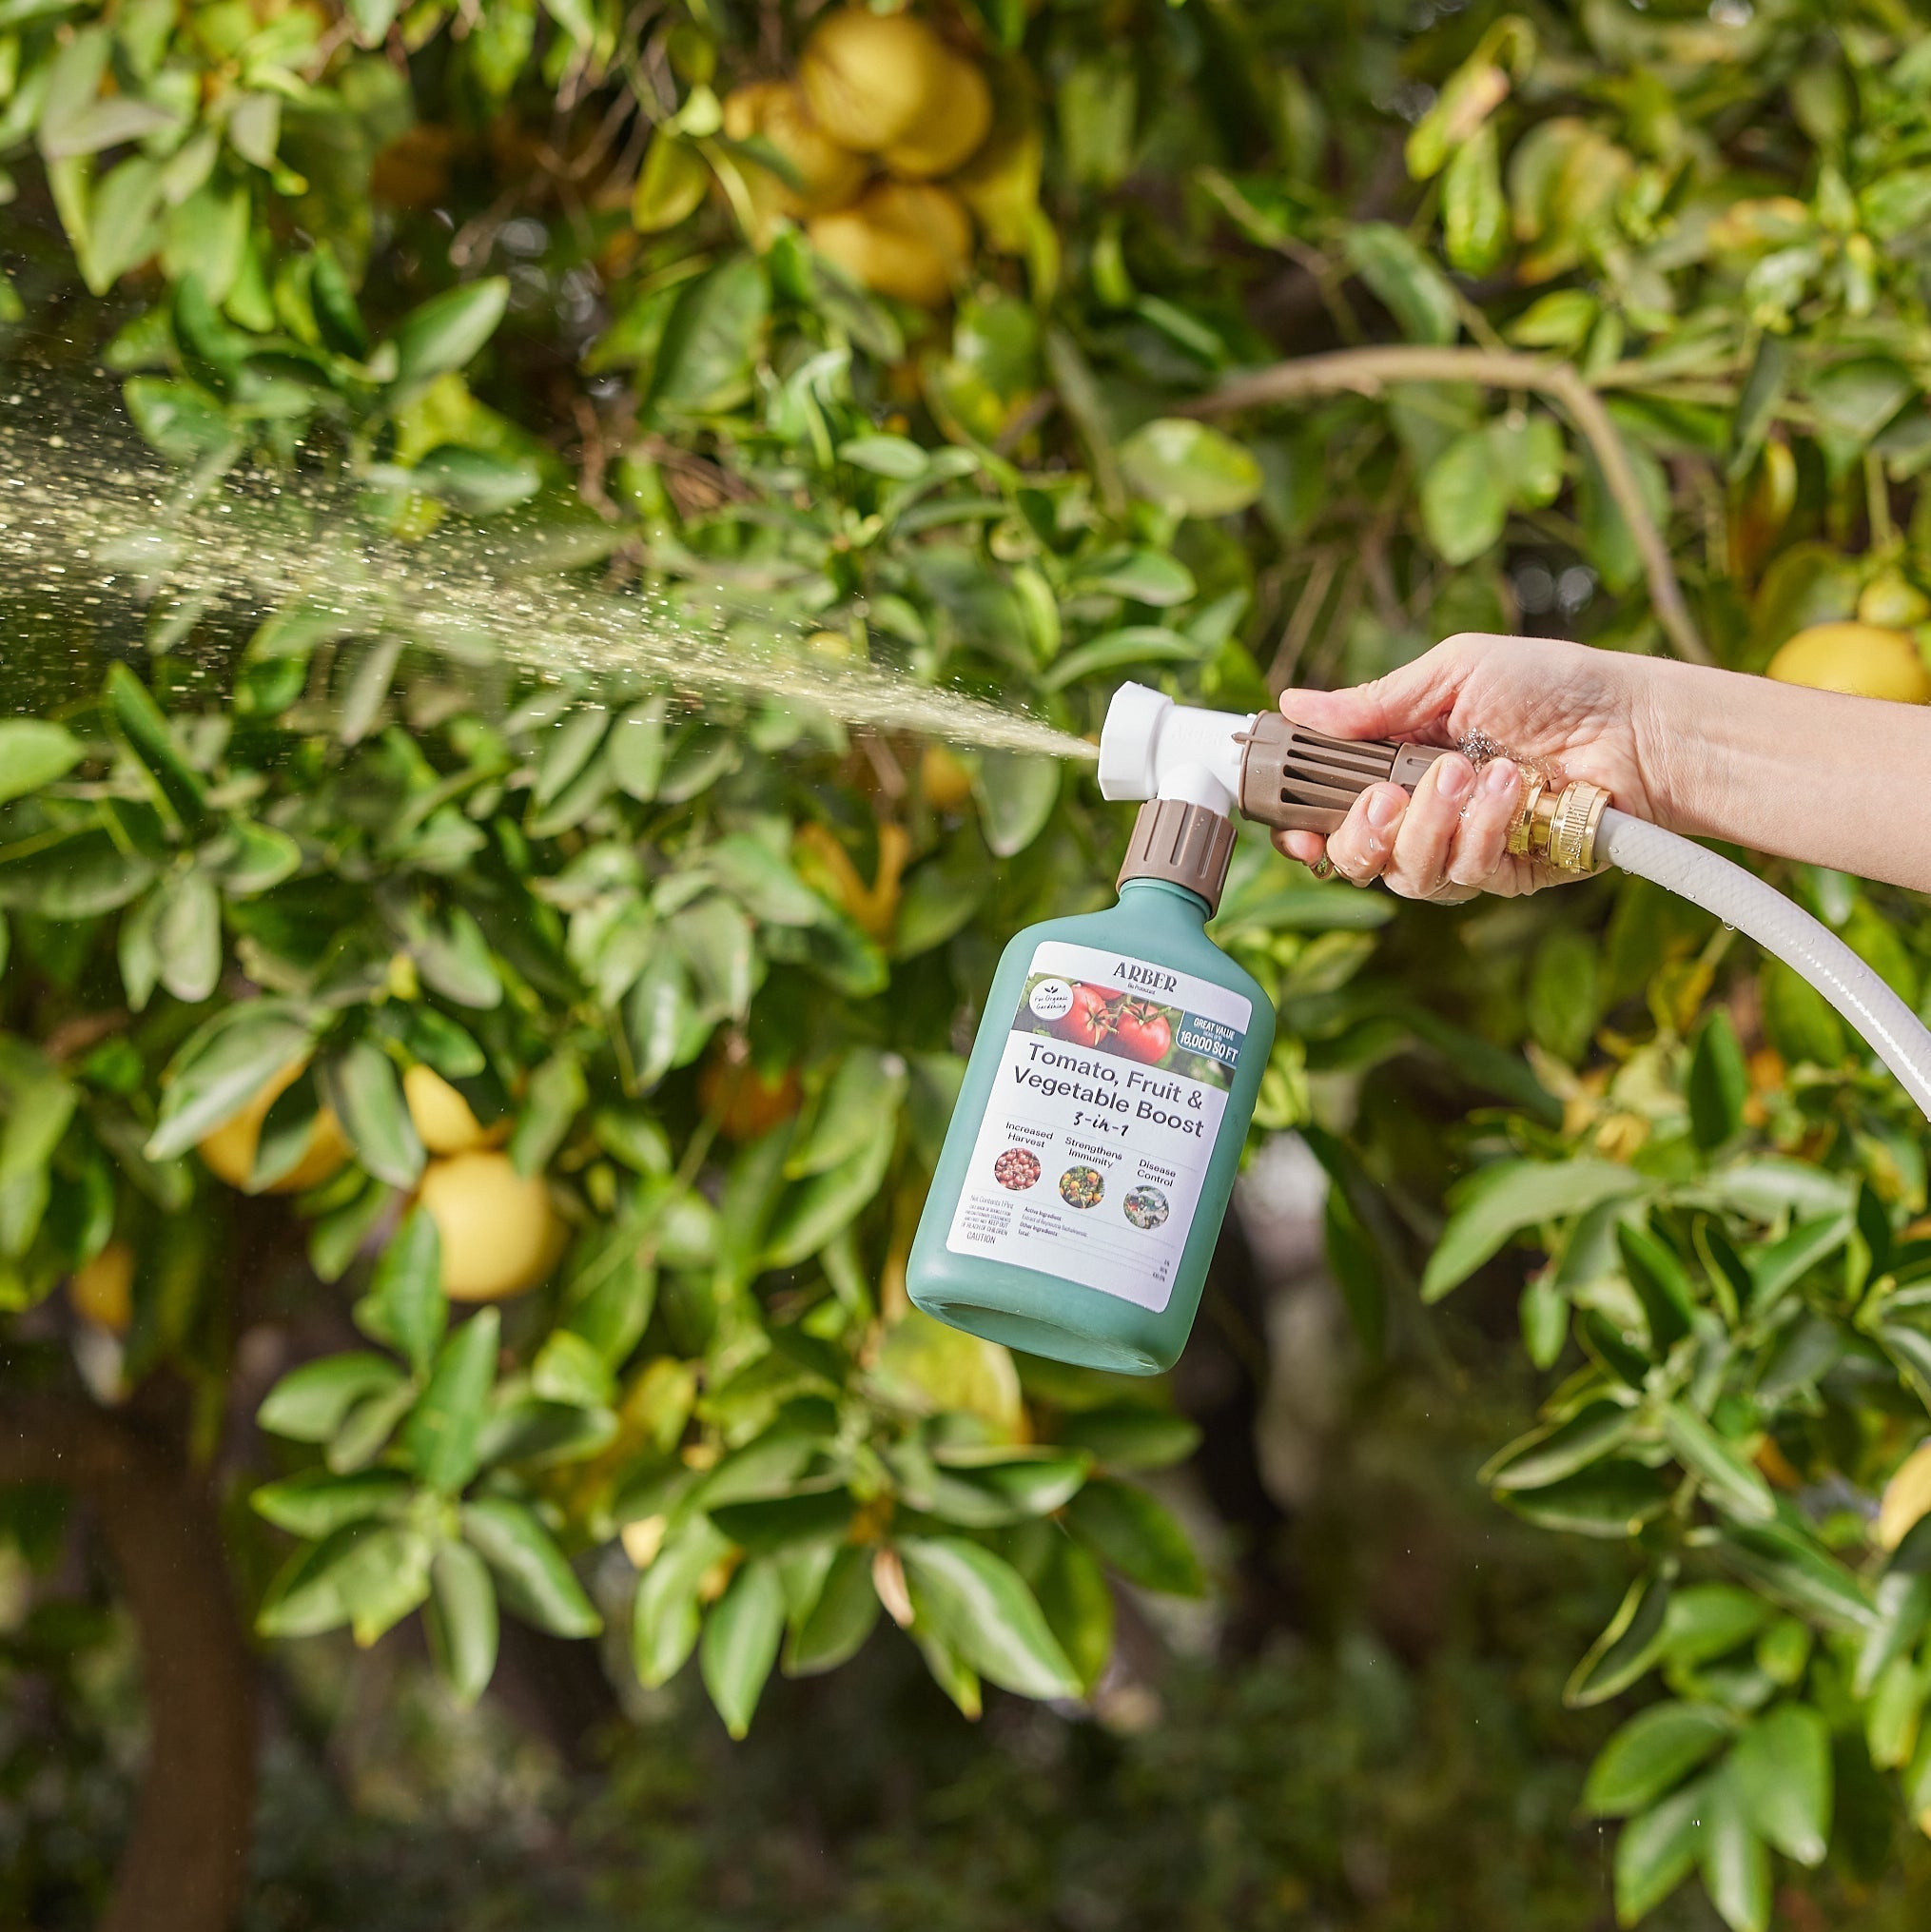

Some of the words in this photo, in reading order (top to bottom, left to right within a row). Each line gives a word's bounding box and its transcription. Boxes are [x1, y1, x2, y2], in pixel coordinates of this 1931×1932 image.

[1112, 961, 1178, 993] ARBER
[1036, 1003, 1067, 1012] Gardening
[1045, 995, 1068, 1005] Organic
[1194, 1018, 1216, 1032] GREAT
[1216, 1025, 1236, 1042] VALUE
[1212, 1041, 1226, 1059] SQ
[1225, 1046, 1239, 1063] FT
[1029, 1042, 1120, 1087] Tomato,
[1126, 1070, 1182, 1103] Fruit
[1187, 1089, 1202, 1110] &
[1015, 1064, 1130, 1113] Vegetable
[1136, 1100, 1204, 1139] Boost
[1005, 1121, 1054, 1141] Increased
[1073, 1111, 1129, 1137] 3-in-1
[1007, 1131, 1045, 1148] Harvest
[1064, 1137, 1122, 1161] Strengthens
[1068, 1147, 1114, 1169] Immunity
[1137, 1169, 1174, 1187] Control
[1139, 1159, 1177, 1178] Disease
[1024, 1206, 1039, 1216] Active
[1019, 1221, 1033, 1230] Other
[966, 1231, 997, 1245] CAUTION
